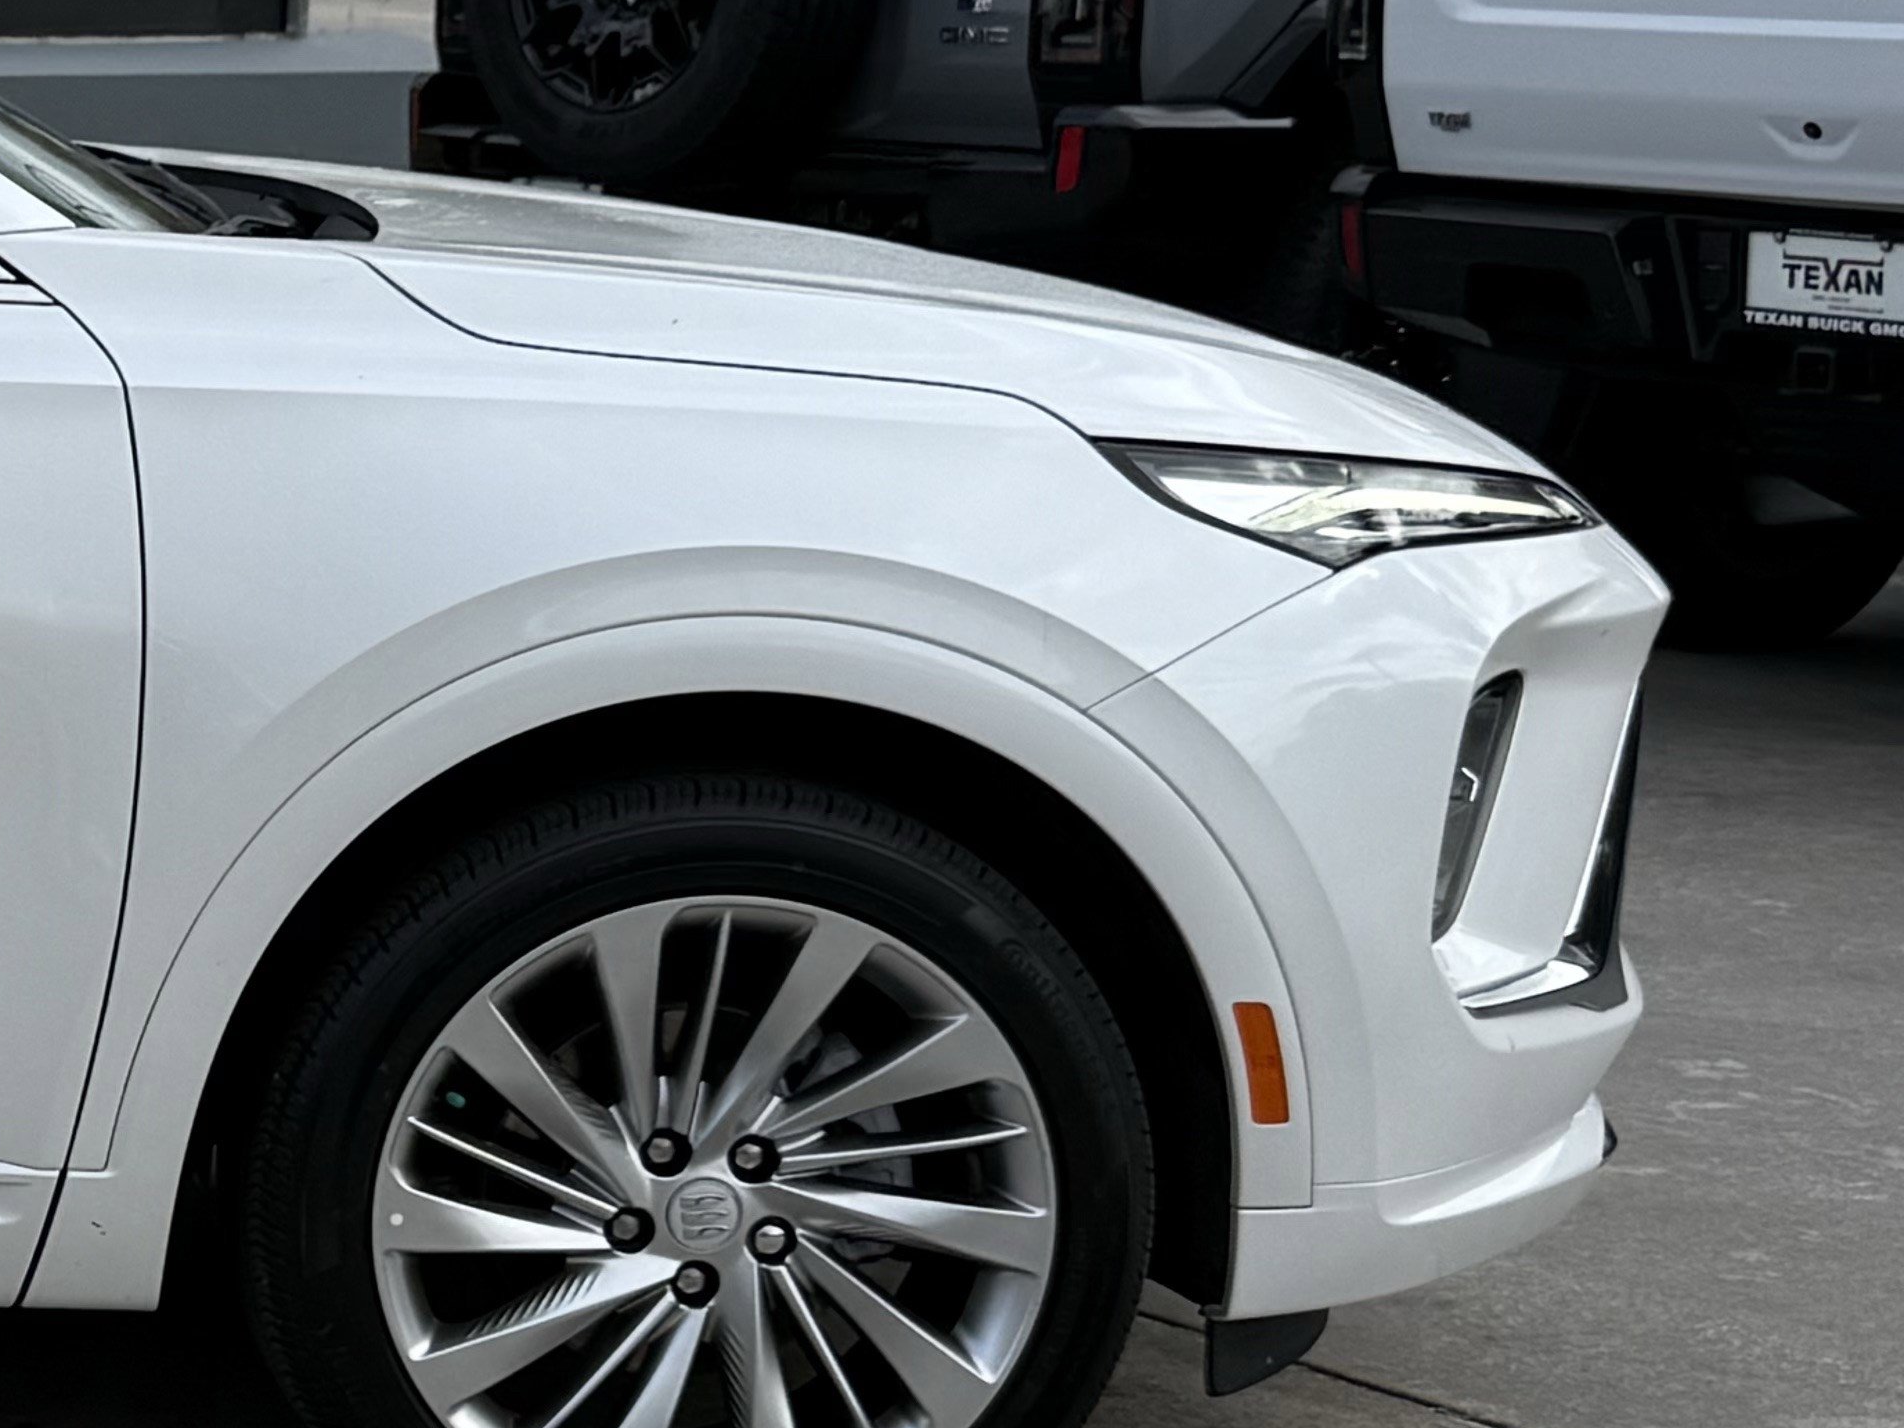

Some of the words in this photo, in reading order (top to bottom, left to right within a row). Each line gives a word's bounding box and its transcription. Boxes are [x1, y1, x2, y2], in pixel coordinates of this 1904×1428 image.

[1782, 254, 1884, 296] TEXAN
[1743, 310, 1803, 328] TEXAN
[1807, 316, 1865, 334] BUICK
